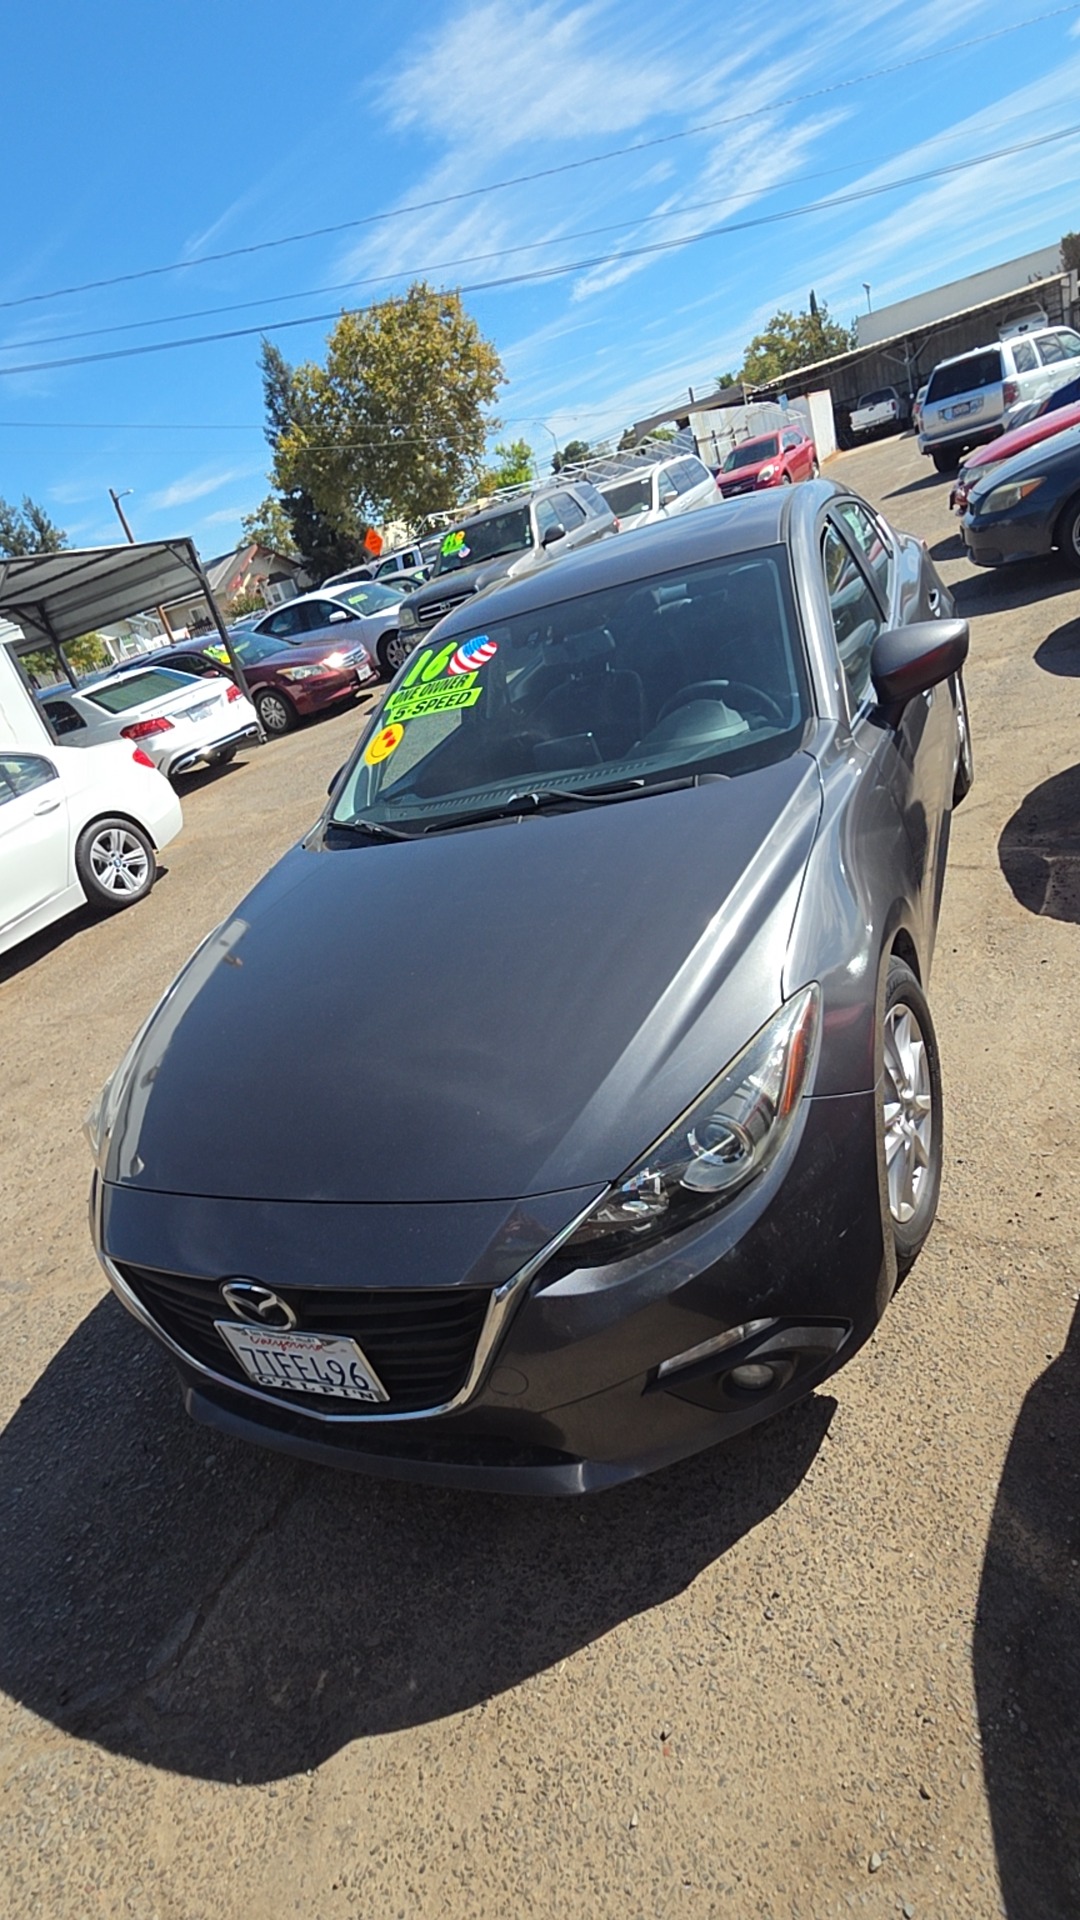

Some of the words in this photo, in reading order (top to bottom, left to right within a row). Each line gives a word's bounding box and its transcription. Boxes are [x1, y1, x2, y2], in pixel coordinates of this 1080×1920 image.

[403, 642, 459, 687] 16
[392, 687, 418, 706] ONE
[419, 675, 470, 697] OWNER
[393, 691, 472, 720] 5-SPEED
[239, 1347, 369, 1390] 7TFE496
